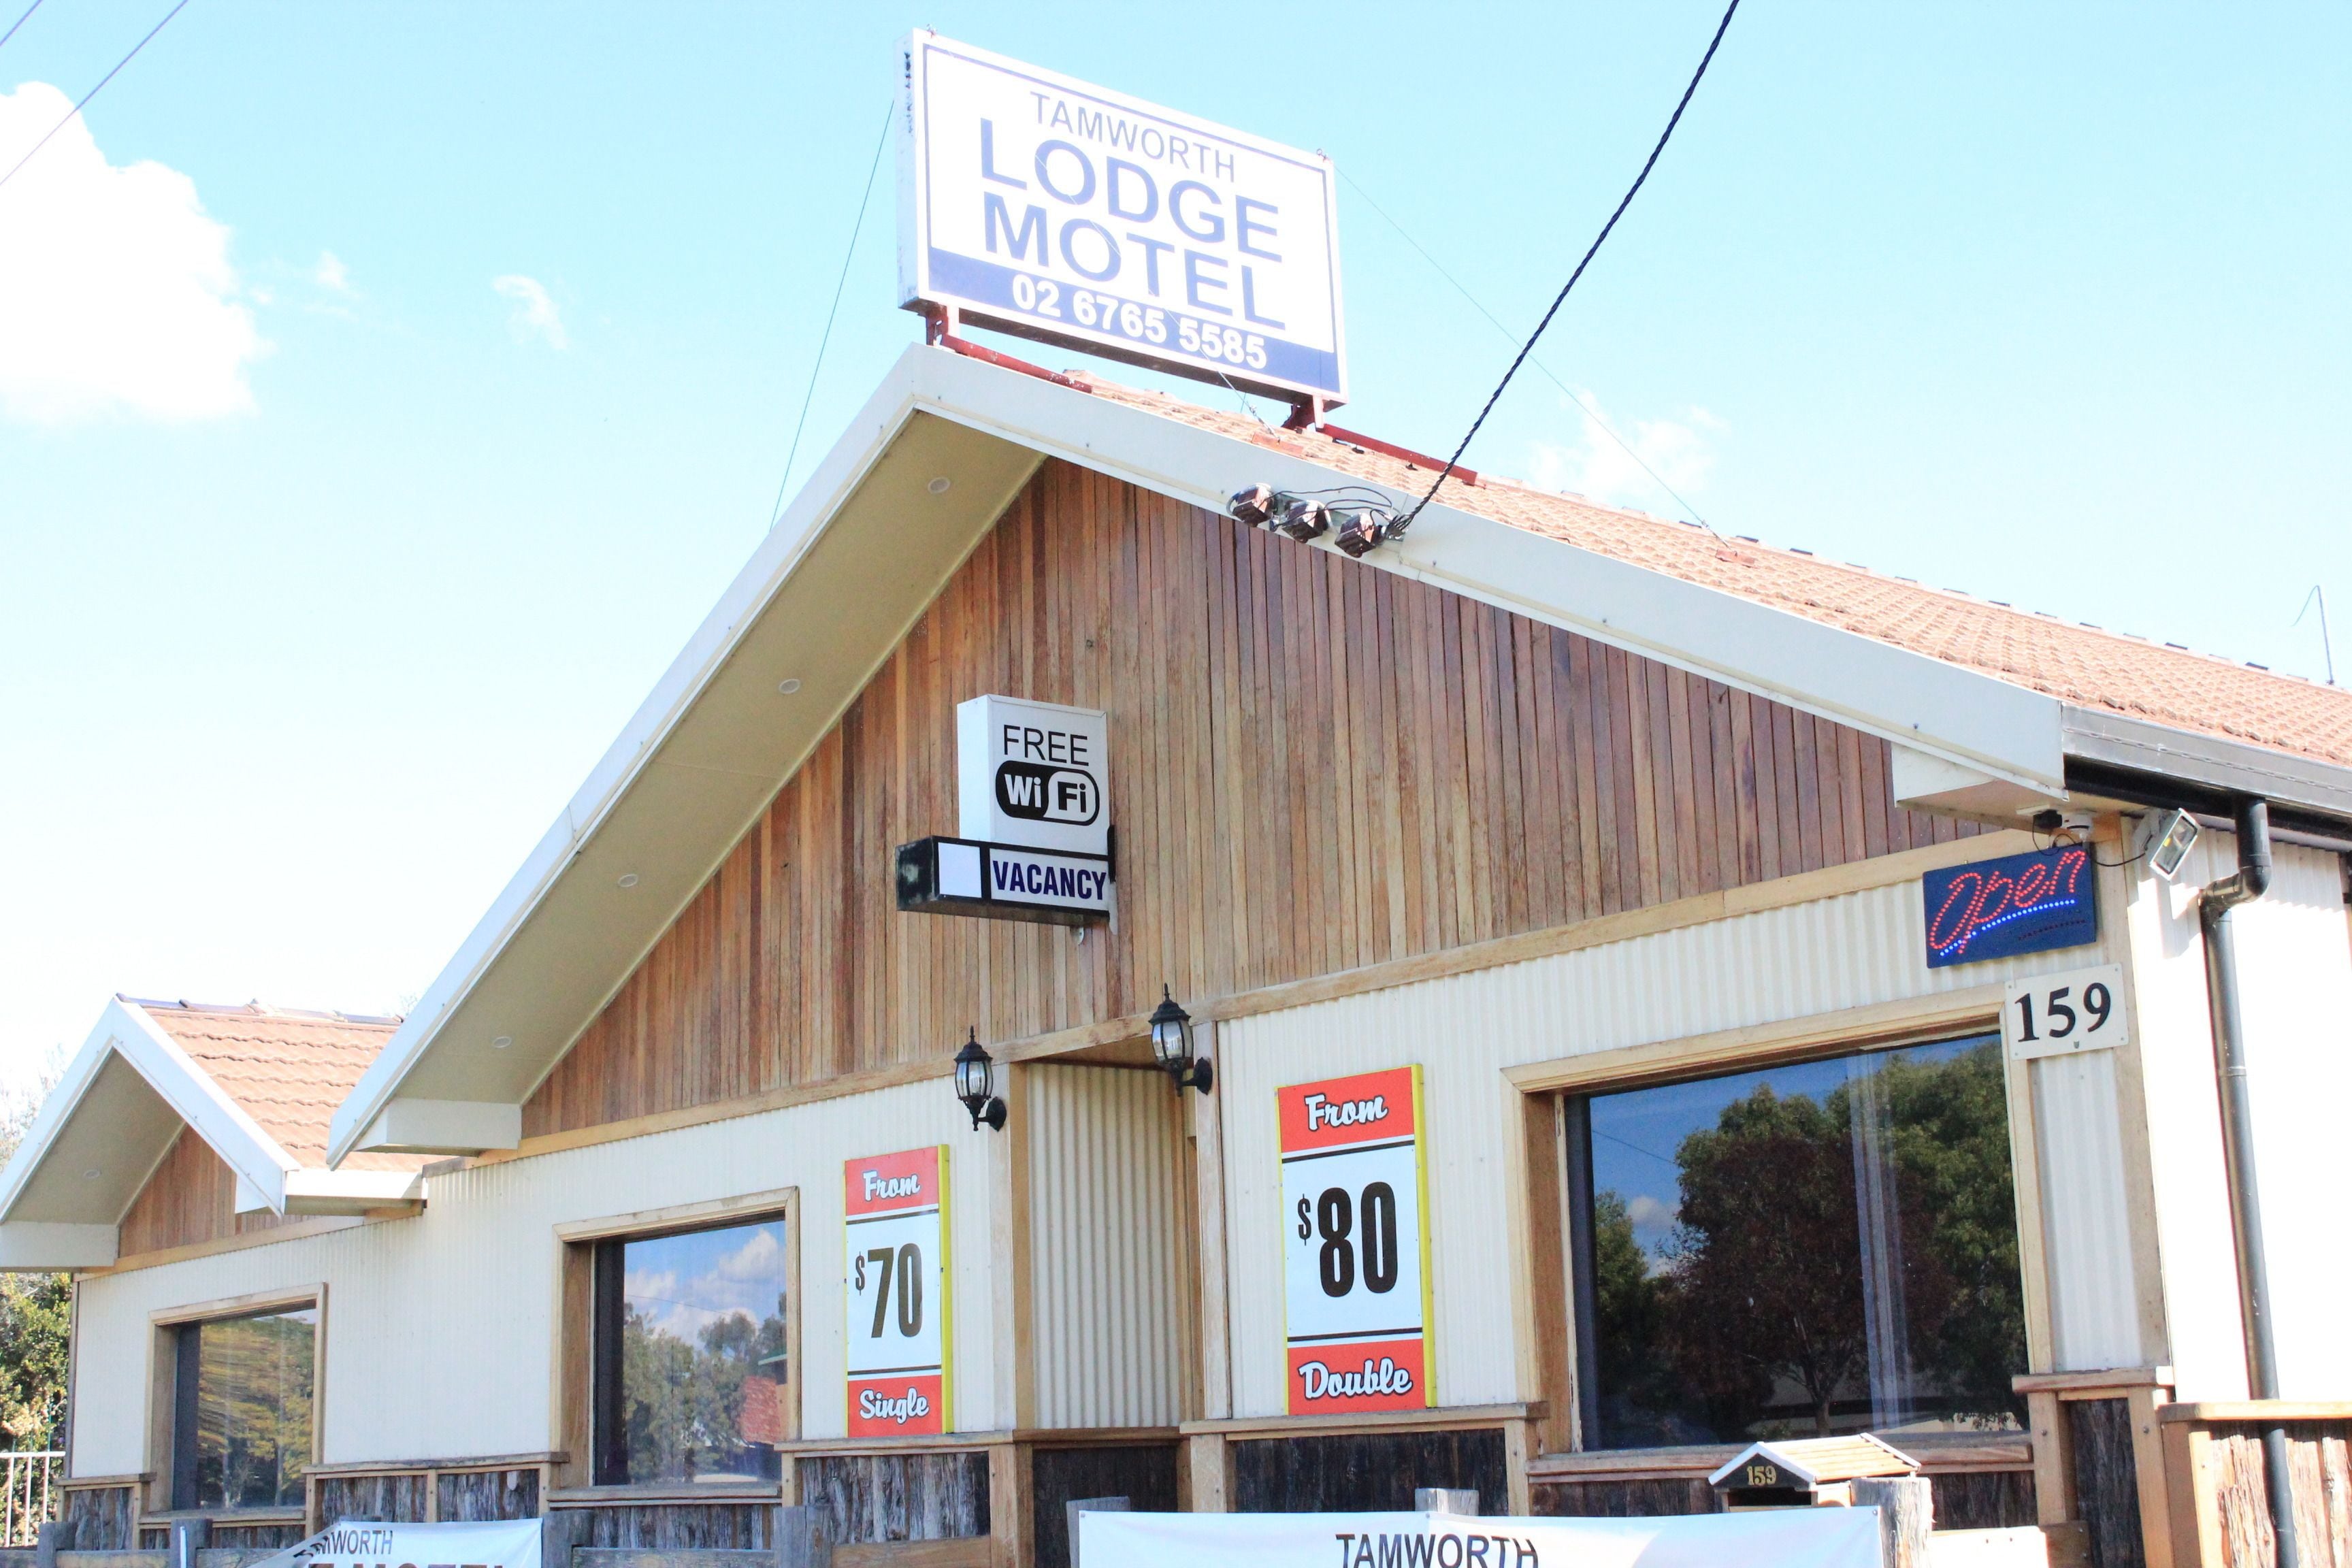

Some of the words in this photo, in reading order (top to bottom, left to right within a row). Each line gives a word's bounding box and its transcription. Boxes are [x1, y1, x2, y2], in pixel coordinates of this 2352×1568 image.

[1030, 91, 1235, 182] TAMWORTH
[981, 117, 1282, 263] LODGE
[983, 191, 1286, 330] MOTEL
[1012, 274, 1061, 317] 02
[1073, 290, 1167, 343] 6765
[1179, 315, 1267, 369] 5585
[1003, 724, 1089, 766] FREE
[993, 860, 1107, 900] VACANCY
[1929, 850, 2086, 954] Open
[2014, 982, 2112, 1043] 159
[1304, 1092, 1389, 1132] From
[863, 1170, 921, 1203] From
[1297, 1181, 1399, 1298] $80
[855, 1243, 923, 1338] $70
[1298, 1356, 1413, 1400] Double
[859, 1387, 930, 1424] Single
[1746, 1465, 1777, 1486] 159
[1335, 1533, 1538, 1568] TAMWORTH
